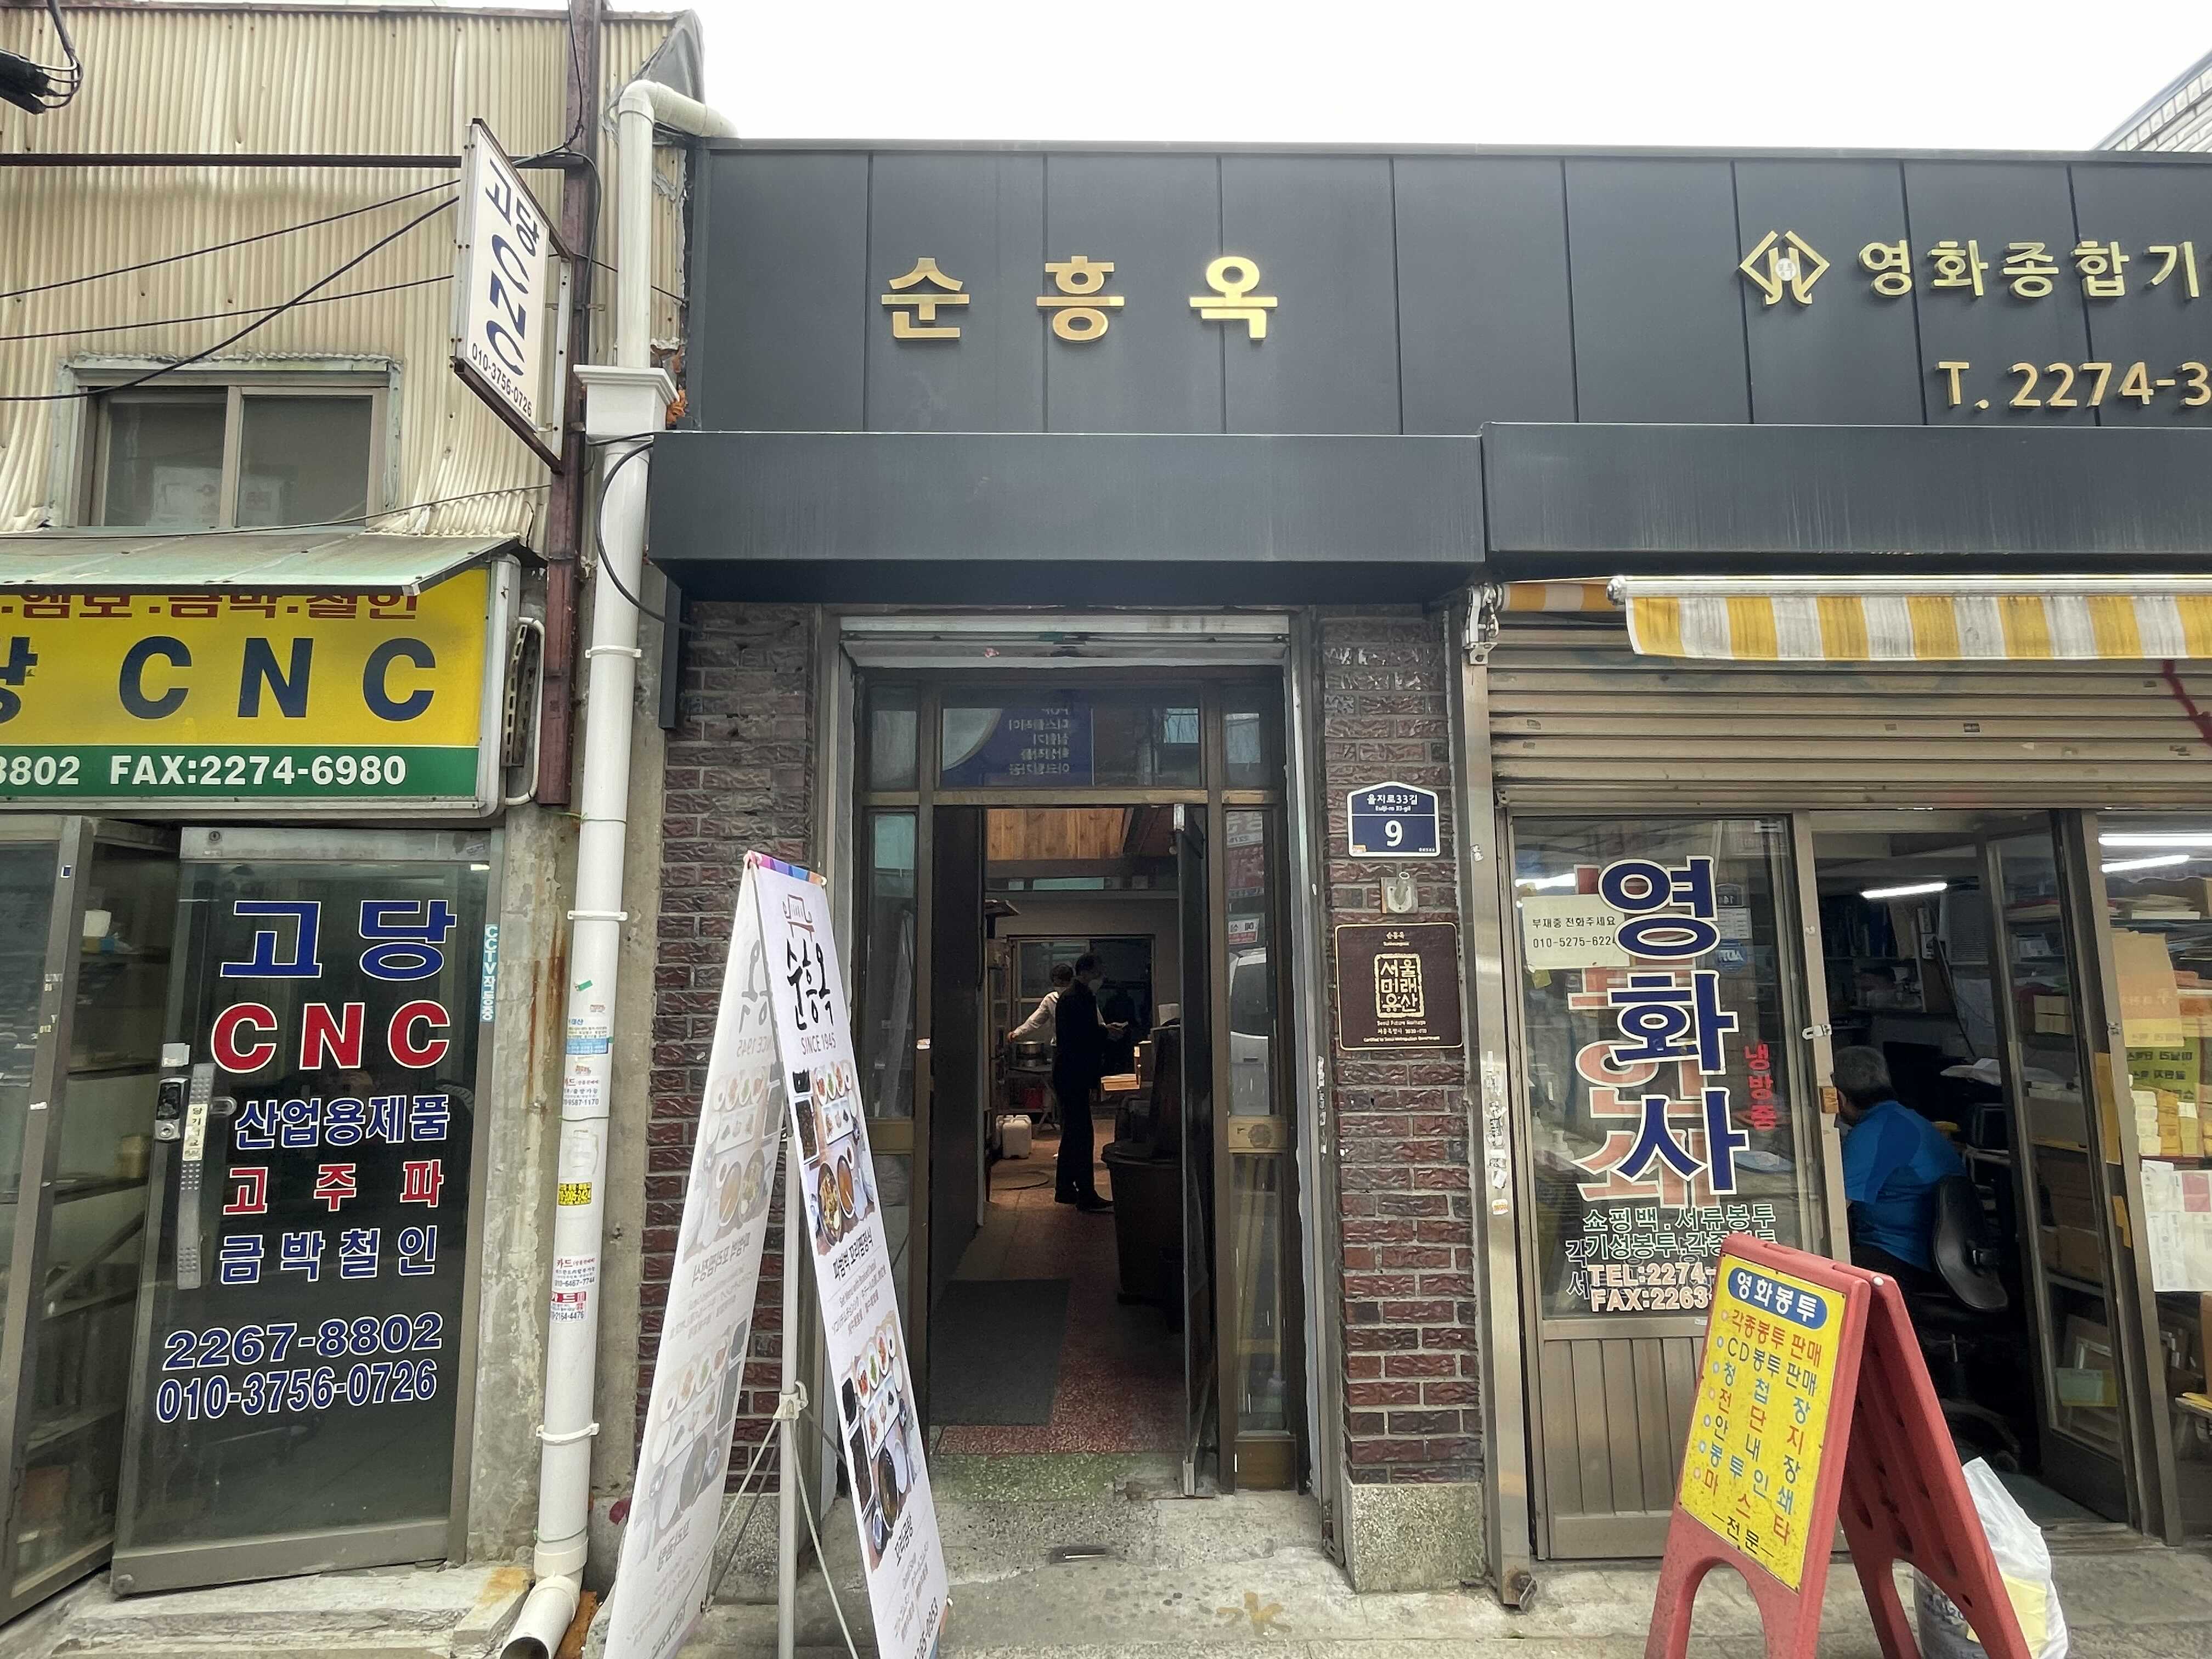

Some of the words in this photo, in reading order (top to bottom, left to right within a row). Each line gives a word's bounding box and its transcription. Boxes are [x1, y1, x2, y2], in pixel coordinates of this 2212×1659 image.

[485, 158, 540, 257] 고당
[486, 234, 529, 377] CNC
[882, 256, 1278, 341] 순흥옥
[471, 342, 533, 417] 010-3756-0726
[119, 636, 436, 721] CNC
[110, 754, 407, 786] FAX:2274-6980
[1367, 793, 1418, 805] 을지로33길
[1384, 820, 1403, 847] 9
[219, 899, 458, 981] 고당
[1532, 917, 1562, 929] 부재중
[1565, 916, 1616, 928] 전화주세요
[1380, 959, 1417, 978] 서울
[1381, 994, 1418, 1013] 유산
[1598, 855, 1750, 1195] 영화사
[211, 1000, 451, 1074] CNC
[801, 1035, 820, 1056] SINCE
[822, 1032, 837, 1051] 1945
[234, 1094, 450, 1150] 산업용제품
[222, 1159, 445, 1216] 고주파
[219, 1224, 438, 1285] 금박철인
[1736, 1271, 1818, 1323] 영화봉투
[162, 1311, 444, 1371] 2267-8802
[1730, 1308, 1786, 1350] 각종봉투
[1790, 1334, 1823, 1369] 판매
[156, 1358, 438, 1423] 010-3756-0726
[1723, 1361, 1811, 1426] 청첩장
[1785, 1364, 1819, 1397] 판매
[1714, 1414, 1802, 1485] 안내장
[1718, 1387, 1806, 1455] 전단지
[1702, 1468, 1792, 1547] 마스타
[1709, 1442, 1796, 1516] 봉투인쇄
